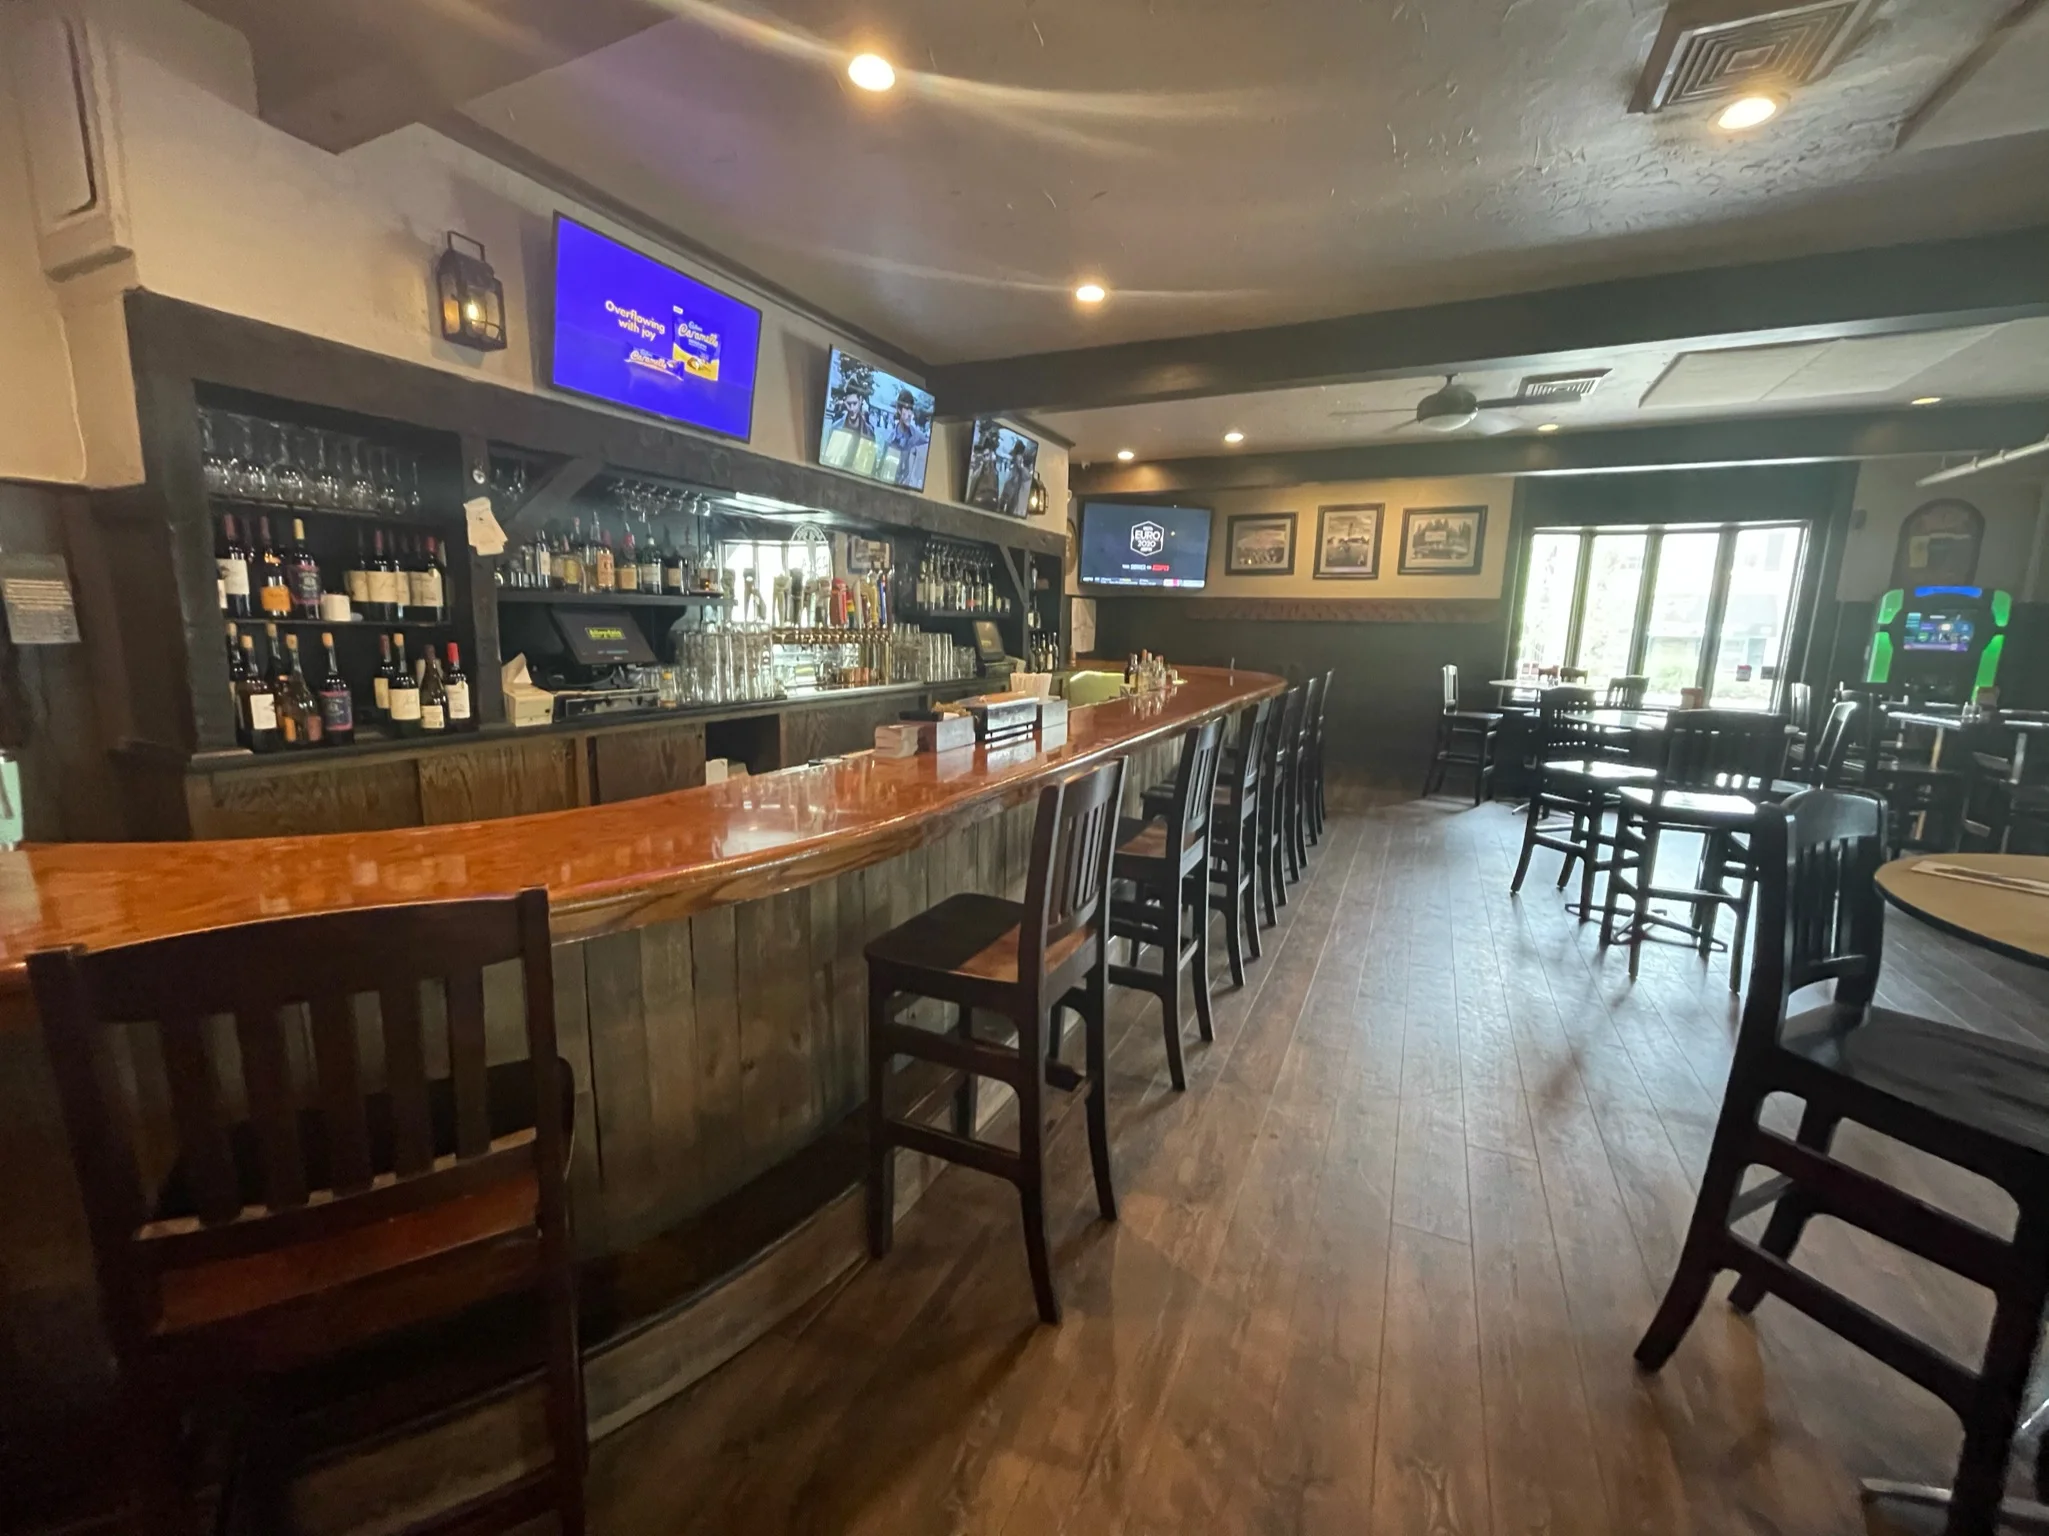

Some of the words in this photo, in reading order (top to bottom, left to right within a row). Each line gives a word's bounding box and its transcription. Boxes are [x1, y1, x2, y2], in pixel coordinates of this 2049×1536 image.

[605, 300, 665, 335] Overflowing
[618, 319, 640, 333] with
[641, 325, 657, 342] joy
[1135, 529, 1160, 540] EURO
